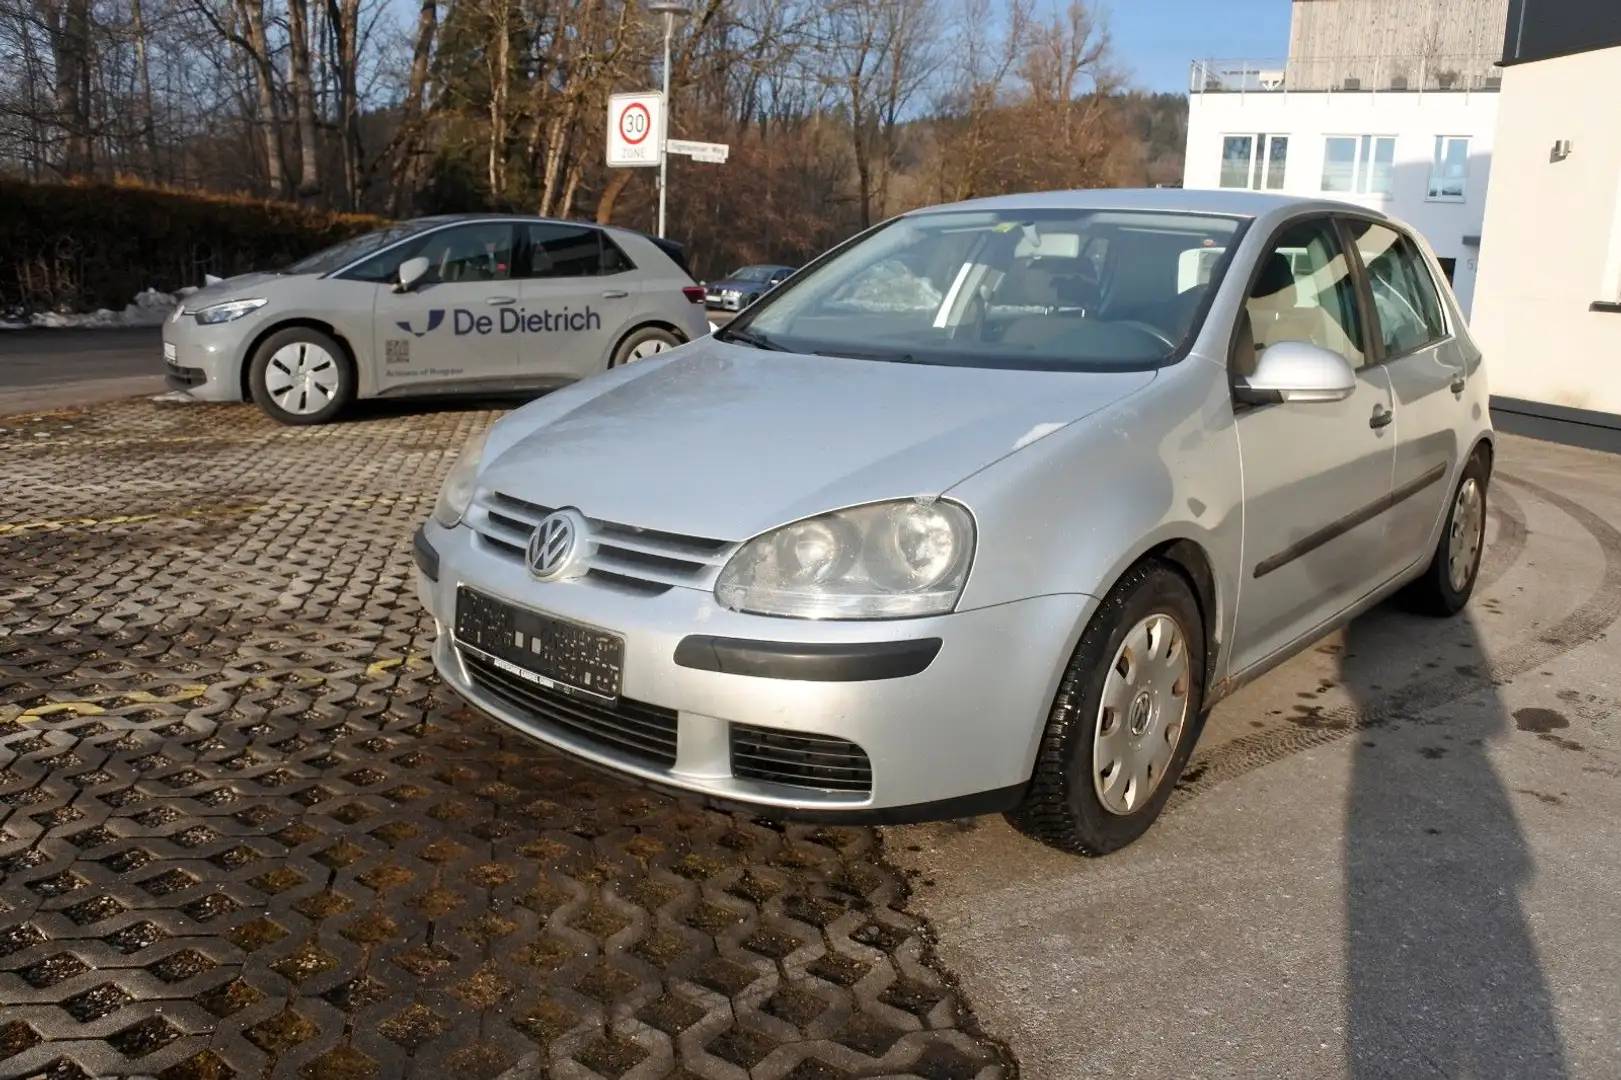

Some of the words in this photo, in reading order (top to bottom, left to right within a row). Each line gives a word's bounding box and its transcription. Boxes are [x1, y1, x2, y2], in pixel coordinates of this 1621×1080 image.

[625, 114, 644, 133] 30
[621, 147, 646, 159] ZONE
[453, 308, 493, 336] De
[500, 305, 601, 335] Dietrich
